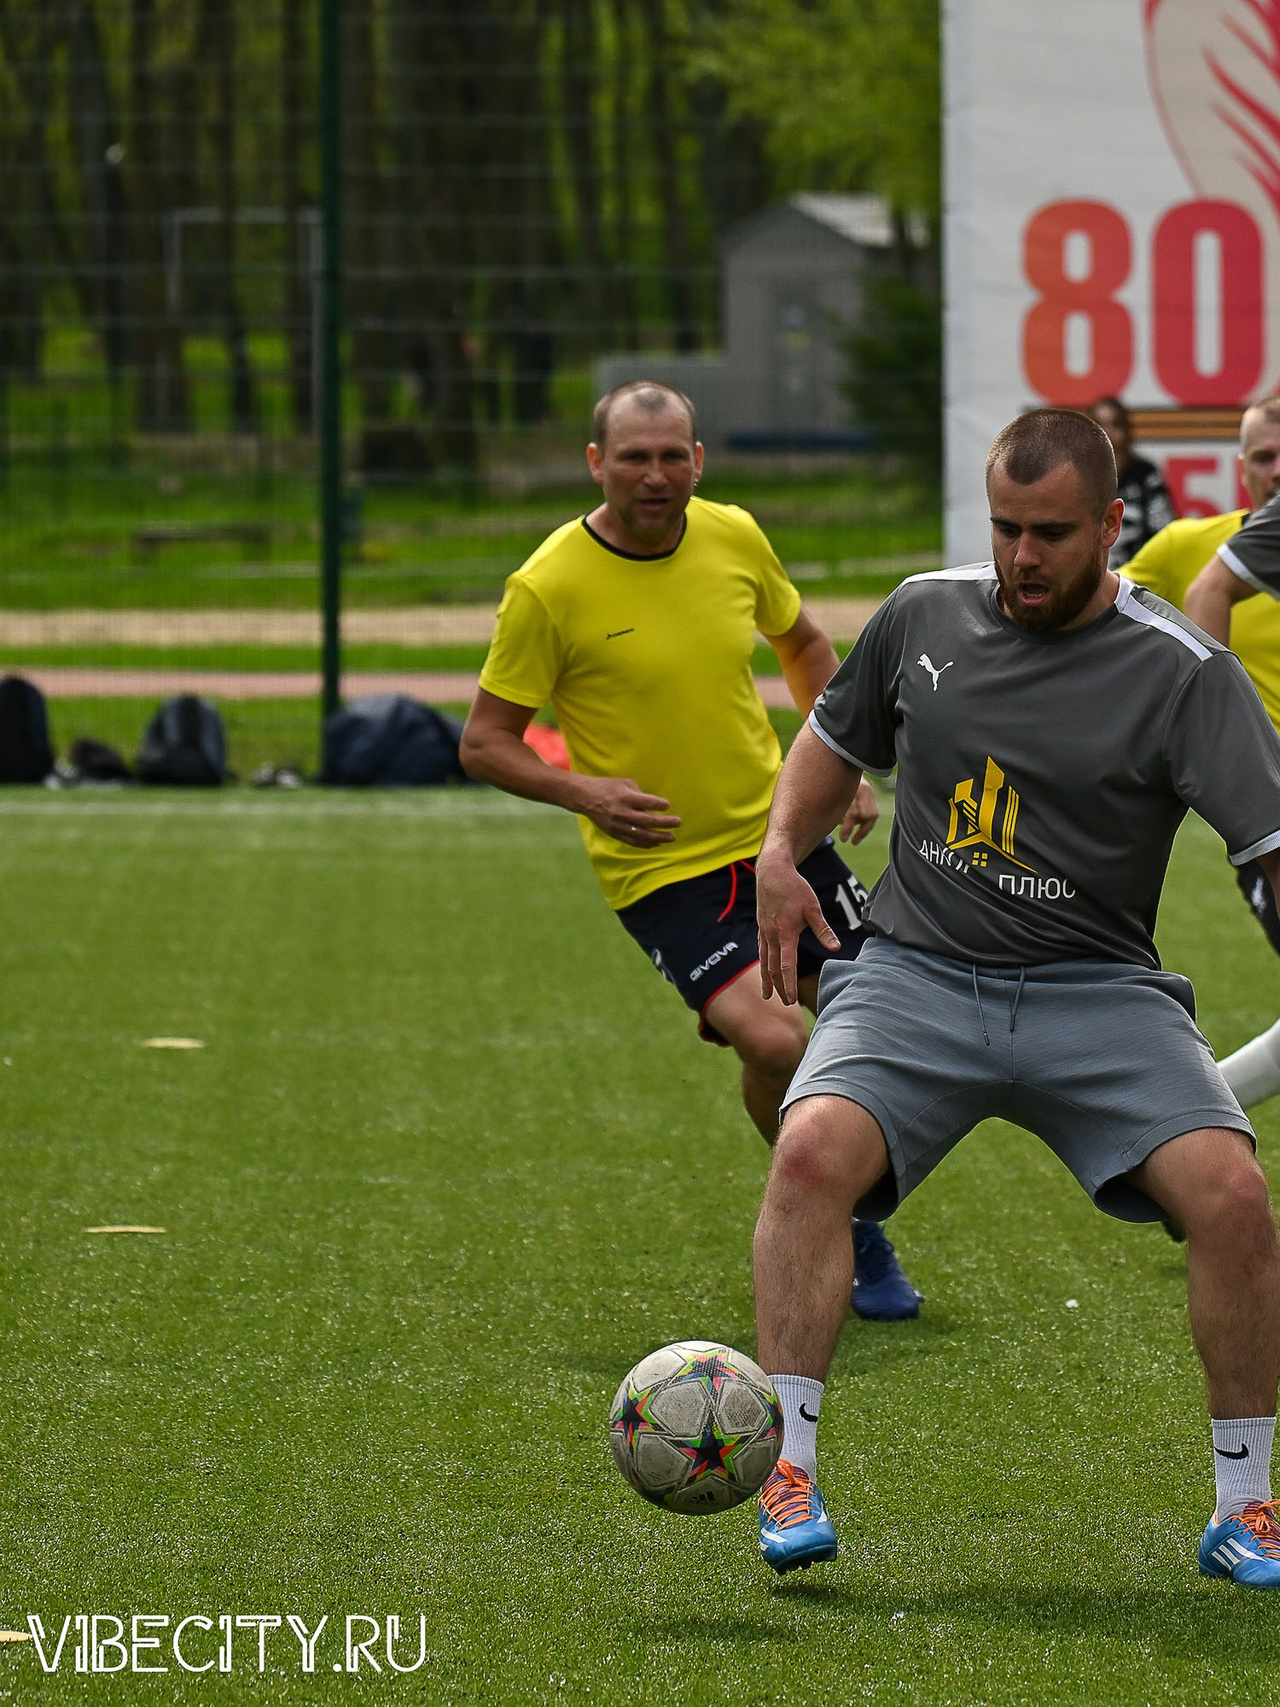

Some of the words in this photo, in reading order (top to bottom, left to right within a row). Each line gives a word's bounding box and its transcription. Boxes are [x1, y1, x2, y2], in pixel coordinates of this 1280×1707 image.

[1021, 198, 1264, 406] 80
[999, 874, 1076, 900] ПЛЮС
[689, 941, 738, 981] GIVOVA
